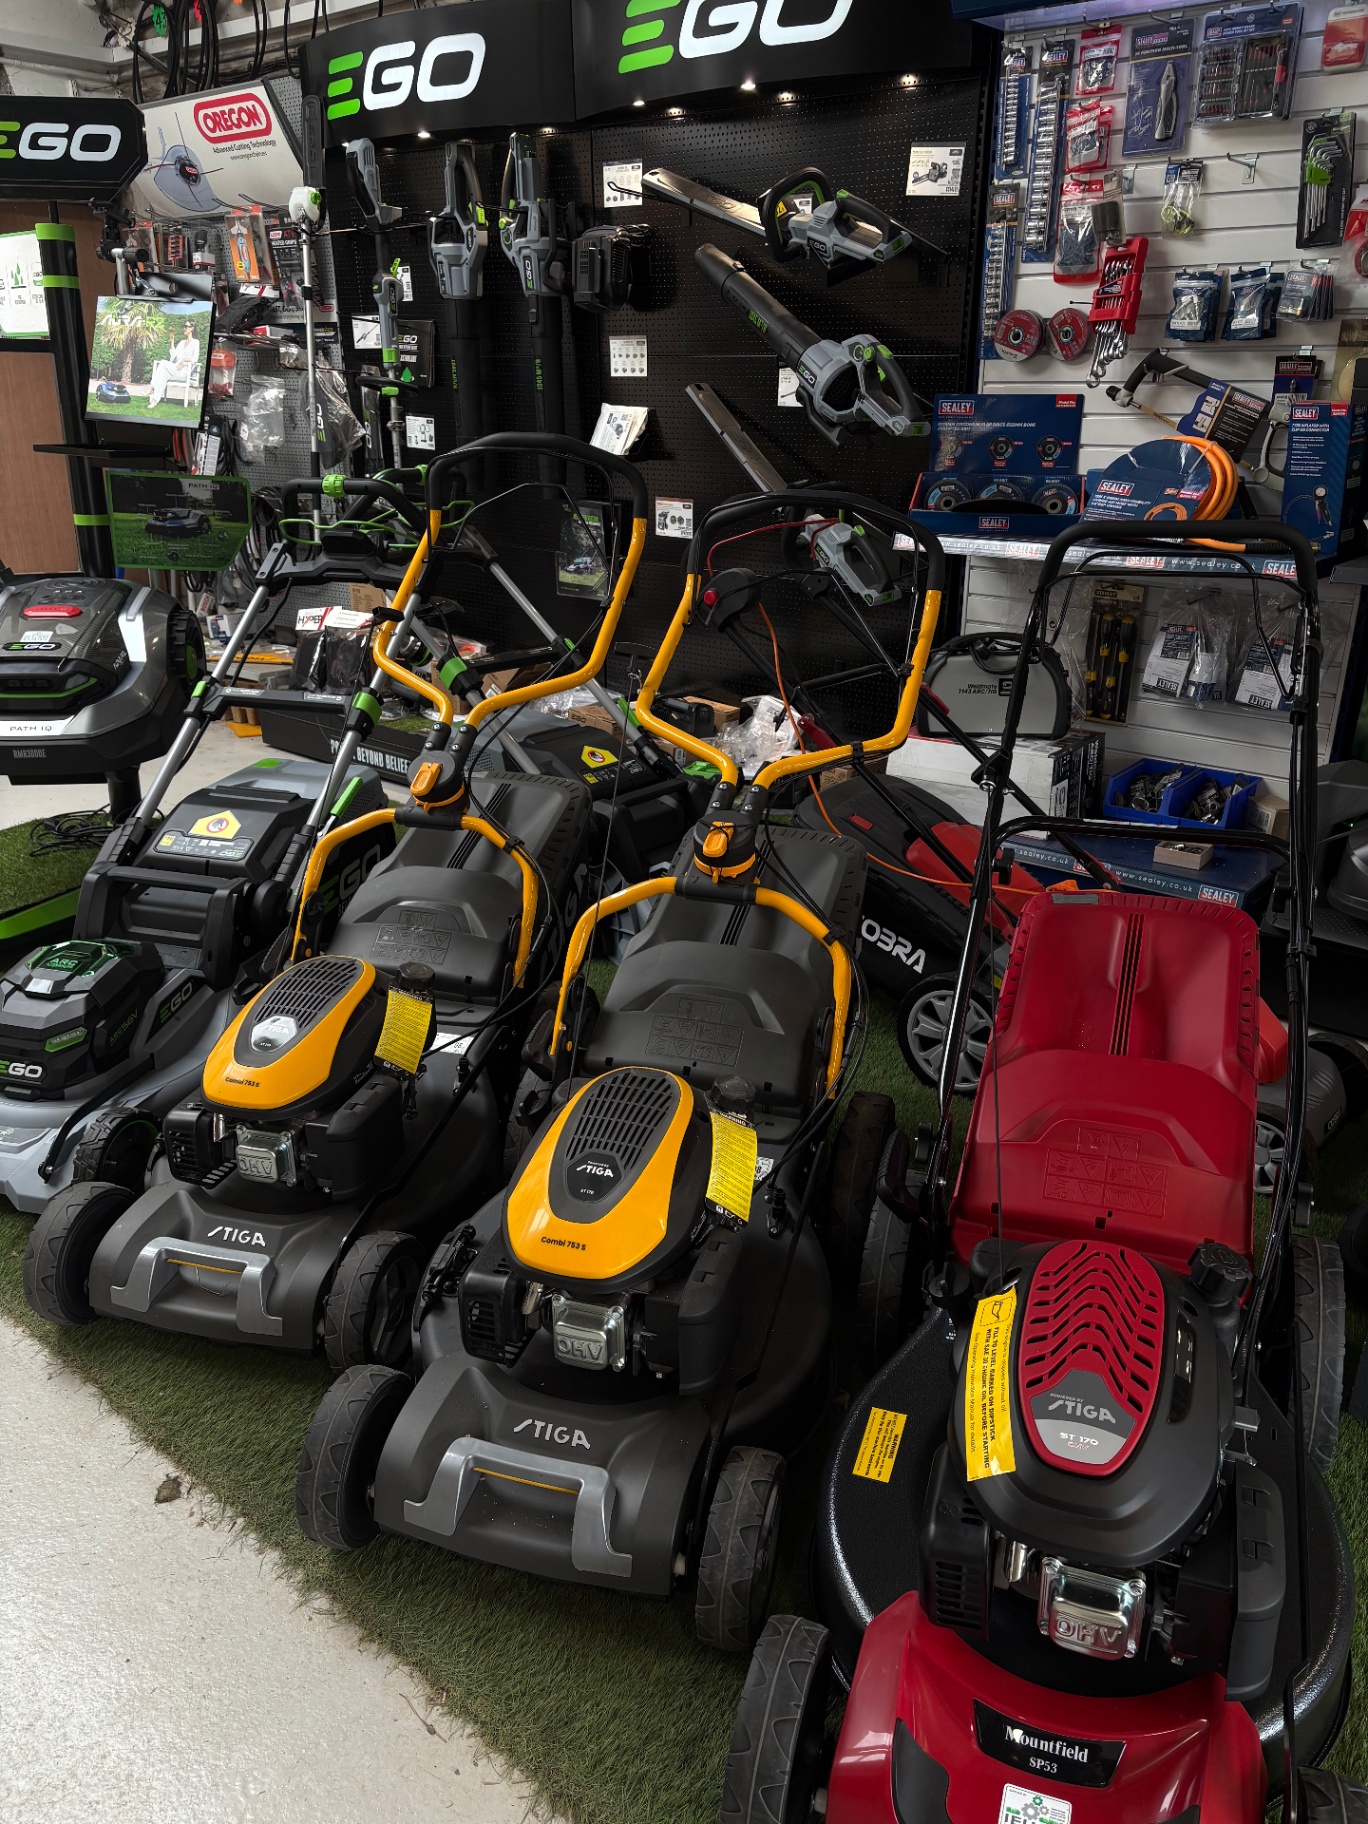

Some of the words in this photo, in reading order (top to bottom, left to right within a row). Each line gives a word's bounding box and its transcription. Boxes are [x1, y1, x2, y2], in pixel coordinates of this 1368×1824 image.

[326, 32, 486, 121] EGO
[202, 104, 262, 134] OREGON
[0, 122, 122, 162] EGO
[212, 145, 234, 154] Advanced
[234, 142, 251, 150] Cutting
[250, 140, 276, 148] Technology
[809, 240, 826, 252] EGO
[526, 260, 534, 290] EGO
[797, 366, 816, 384] EGO
[942, 403, 972, 413] SEALEY
[1294, 409, 1317, 418] SEALEY
[1101, 482, 1130, 494] SEALEY
[982, 518, 1006, 527] SEALEY
[1007, 544, 1038, 556] SEALEY
[1130, 556, 1162, 567] SEALEY
[1171, 558, 1256, 571] www.sealey.co.k
[1266, 563, 1297, 576] SEALE
[200, 597, 210, 612] BOSCH
[1158, 678, 1178, 691] SEALEY
[1251, 696, 1272, 708] SEALEY
[571, 714, 586, 723] EGO
[357, 746, 384, 768] BEYOND
[386, 752, 408, 774] BELIEF
[1115, 870, 1193, 893] www.sealey.co.uk
[1202, 888, 1236, 905] SEALEY
[862, 916, 926, 974] OBRA
[160, 982, 194, 1024] EGO
[122, 1008, 138, 1034] 56V
[260, 1021, 289, 1035] STIGA
[0, 1059, 43, 1078] EGO
[225, 1076, 244, 1086] Combi
[244, 1078, 256, 1087] 753
[720, 1112, 746, 1126] WARNING
[576, 1164, 614, 1178] STIGA
[207, 1226, 266, 1247] STIGA
[541, 1236, 566, 1247] Combi
[566, 1240, 580, 1250] 753
[557, 1337, 604, 1362] OHV
[971, 1343, 979, 1368] Operating
[989, 1396, 995, 1406] ON
[1048, 1400, 1116, 1424] STIGA
[514, 1418, 591, 1450] STIGA
[1060, 1432, 1076, 1440] ST
[1080, 1436, 1099, 1446] 170
[888, 1434, 900, 1459] WARNING
[1056, 1616, 1122, 1646] OHV
[1004, 1724, 1089, 1763] Mountfield
[1028, 1756, 1058, 1774] SP53
